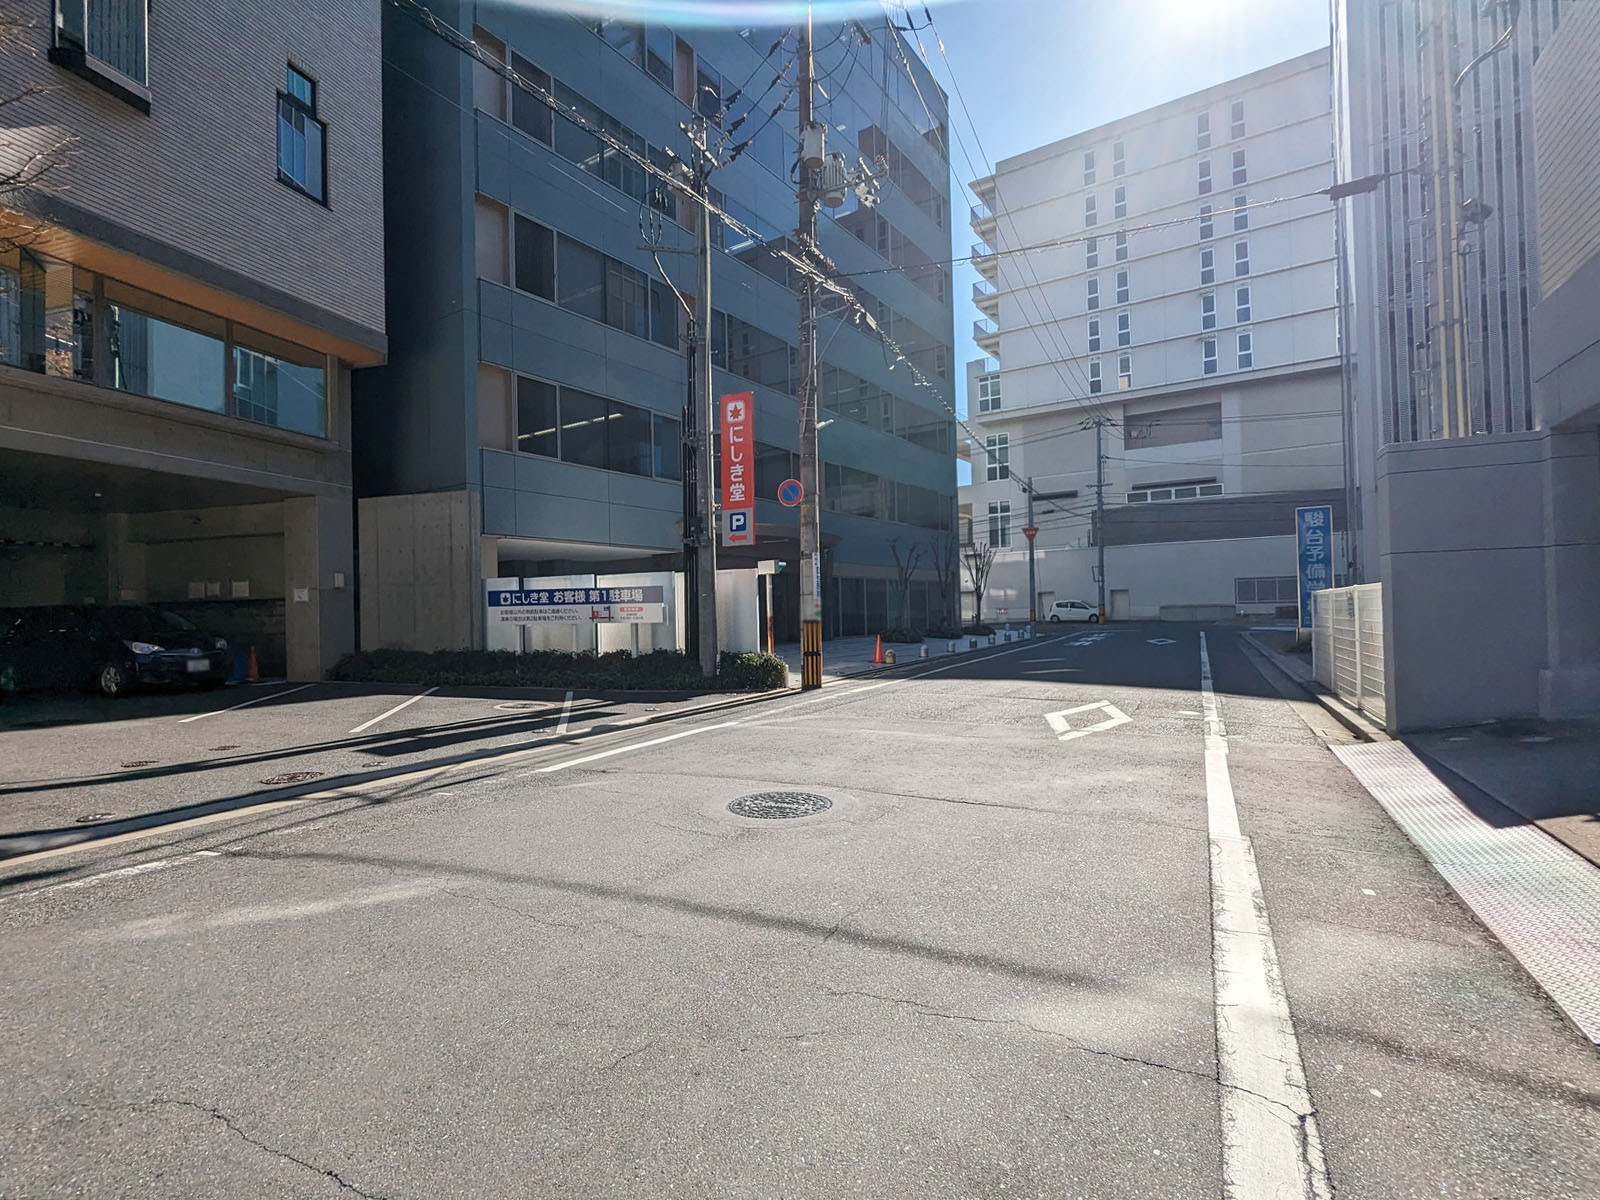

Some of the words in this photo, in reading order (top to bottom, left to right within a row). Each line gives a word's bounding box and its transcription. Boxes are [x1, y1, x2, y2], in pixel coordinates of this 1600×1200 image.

[729, 426, 745, 502] にしき堂
[732, 514, 744, 530] P
[512, 593, 549, 604] にしき堂
[553, 591, 586, 602] お客様
[589, 589, 643, 603] 第1駐車場
